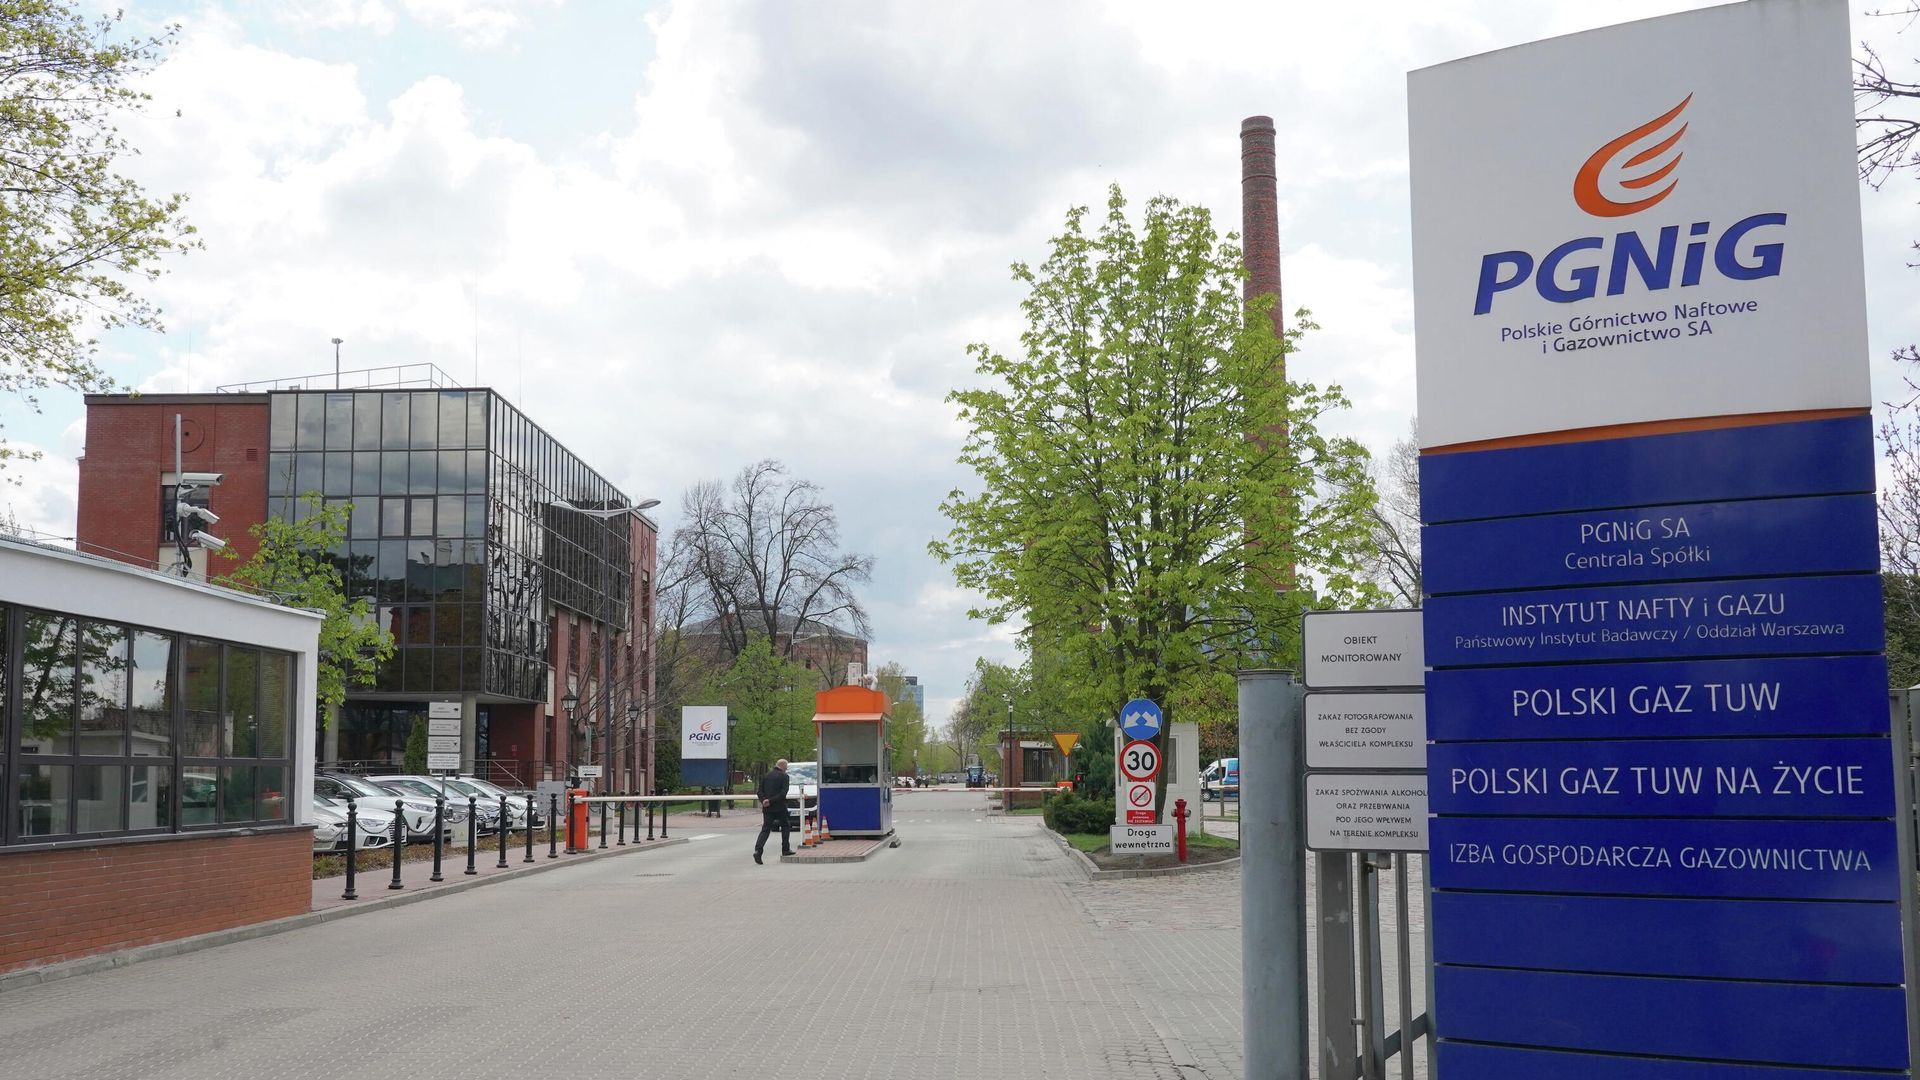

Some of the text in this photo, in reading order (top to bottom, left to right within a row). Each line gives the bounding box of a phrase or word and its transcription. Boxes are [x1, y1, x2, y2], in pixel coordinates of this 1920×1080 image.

[1473, 213, 1787, 316] PGNiG
[1501, 299, 1758, 342] Polskie Górnictwo Naftowe
[1554, 326, 1680, 352] Gazownictwo
[1688, 320, 1712, 336] SA
[1581, 518, 1690, 544] PGNiG SA
[1565, 545, 1710, 570] Centrala Spółki
[1503, 601, 1610, 626] INSTYTUT
[1619, 597, 1694, 619] NAFTY
[1718, 593, 1785, 616] GAZU
[1344, 636, 1377, 644] OBIEKT
[1456, 633, 1535, 650] Państwowy
[1541, 631, 1596, 645] Instytut
[1601, 627, 1677, 644] Badawczy
[1697, 623, 1756, 638] Oddział
[1761, 622, 1844, 636] Warszawa
[1322, 654, 1402, 662] MONITOROWANY
[1513, 682, 1780, 717] POLSKI GAZ TUW
[689, 732, 720, 740] PGNiG
[1127, 751, 1154, 771] 30
[1452, 760, 1864, 794] POLSKI GAZ TUW NA ŻYCIE
[1342, 788, 1388, 796] SPOŻYWANIA
[1128, 829, 1156, 838] Droga
[1450, 844, 1871, 871] IZBA GOSPODARCZA GAZOWNICTWA
